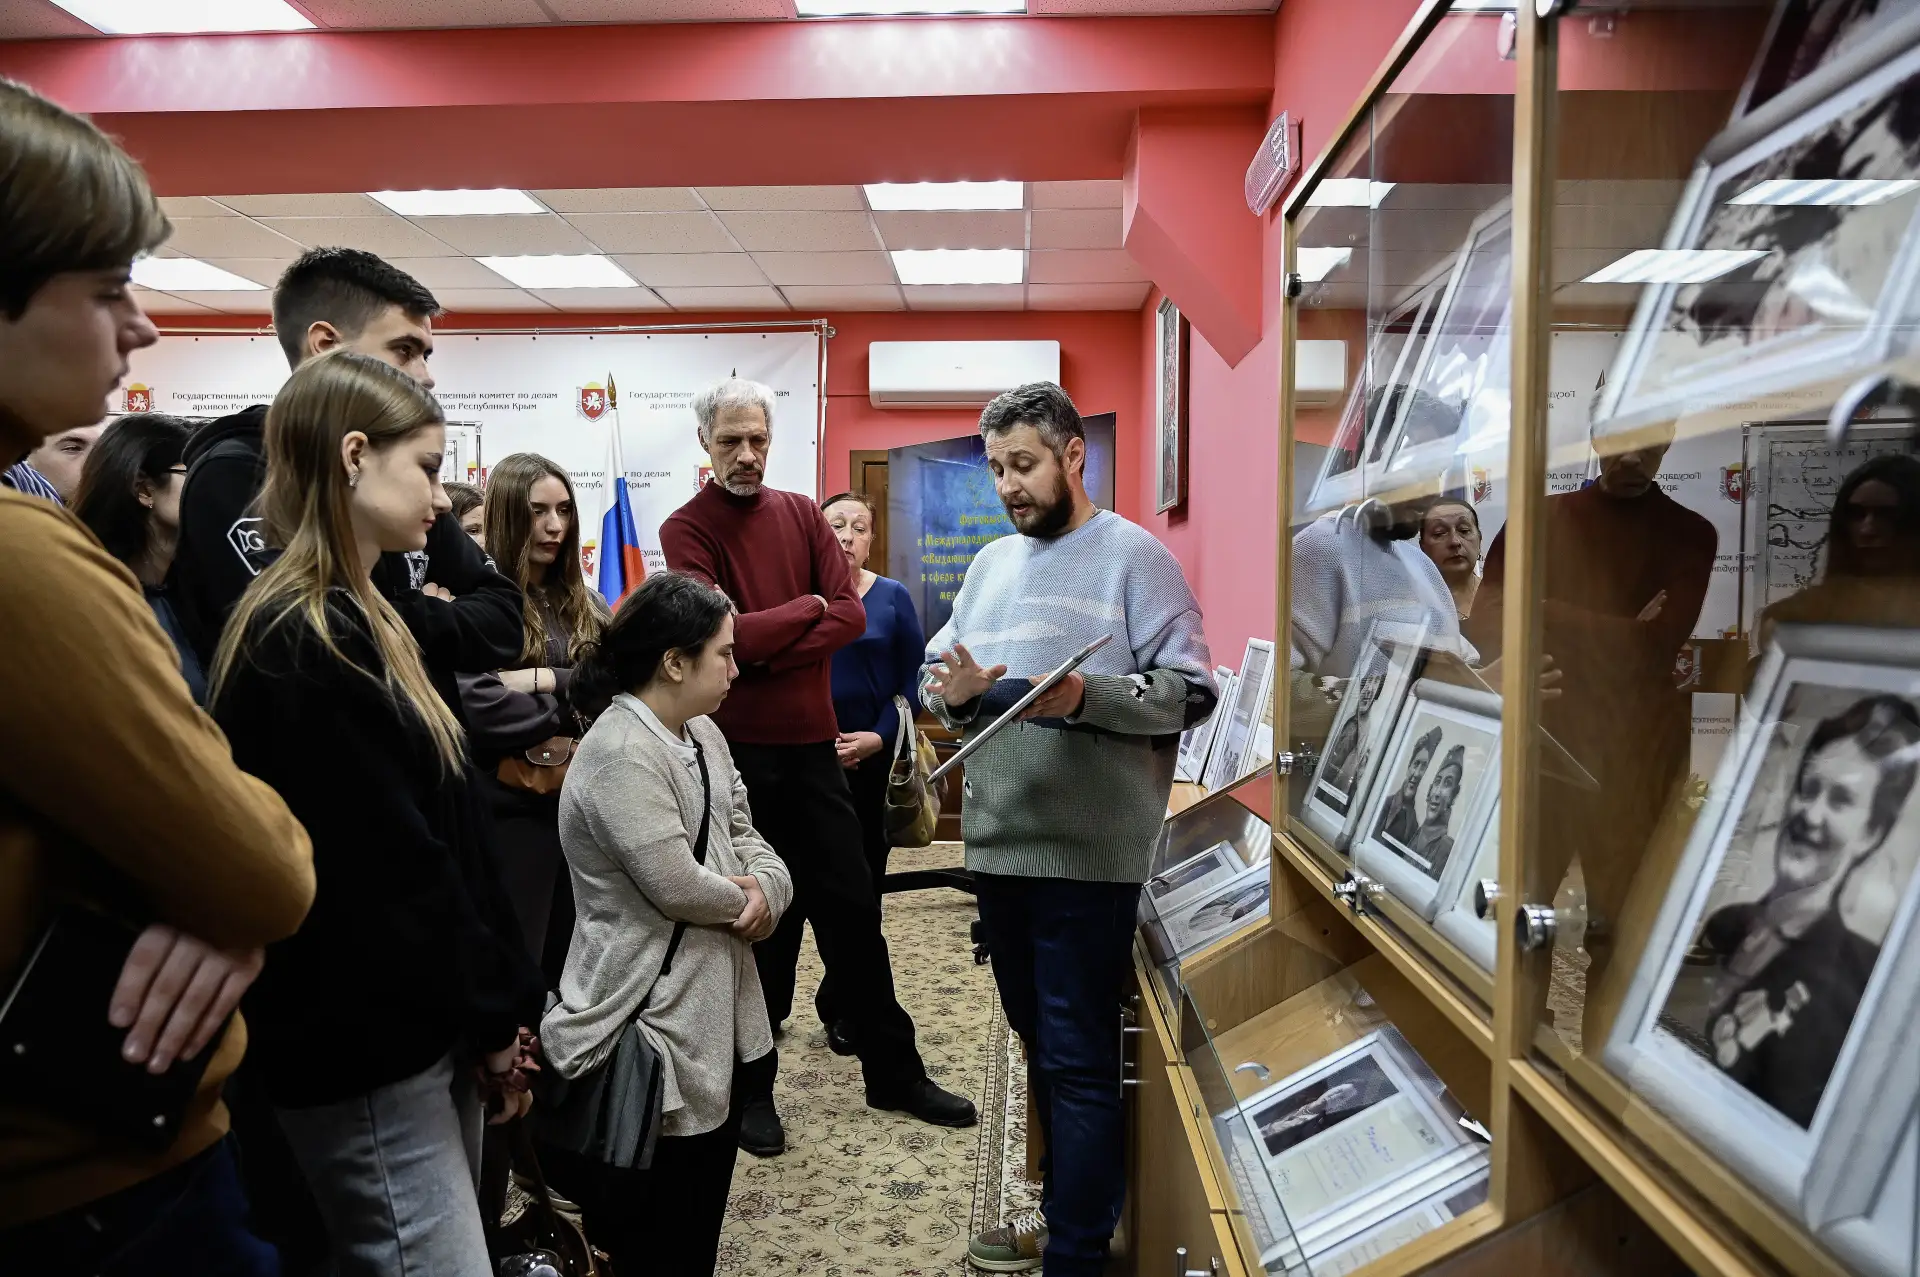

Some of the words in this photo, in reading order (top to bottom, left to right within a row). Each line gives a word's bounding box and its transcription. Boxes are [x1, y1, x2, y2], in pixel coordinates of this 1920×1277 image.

[172, 392, 249, 401] Государственный
[433, 391, 476, 399] ственный
[531, 392, 558, 400] делам
[629, 391, 695, 400] Государственн
[192, 403, 229, 411] архивов
[458, 402, 510, 412] Республики
[512, 402, 537, 411] Крым
[649, 402, 687, 410] архивов
[625, 481, 651, 490] Крым
[959, 514, 1008, 527] Фотовыст
[917, 538, 922, 546] к
[921, 573, 926, 582] в
[929, 570, 955, 585] сфере
